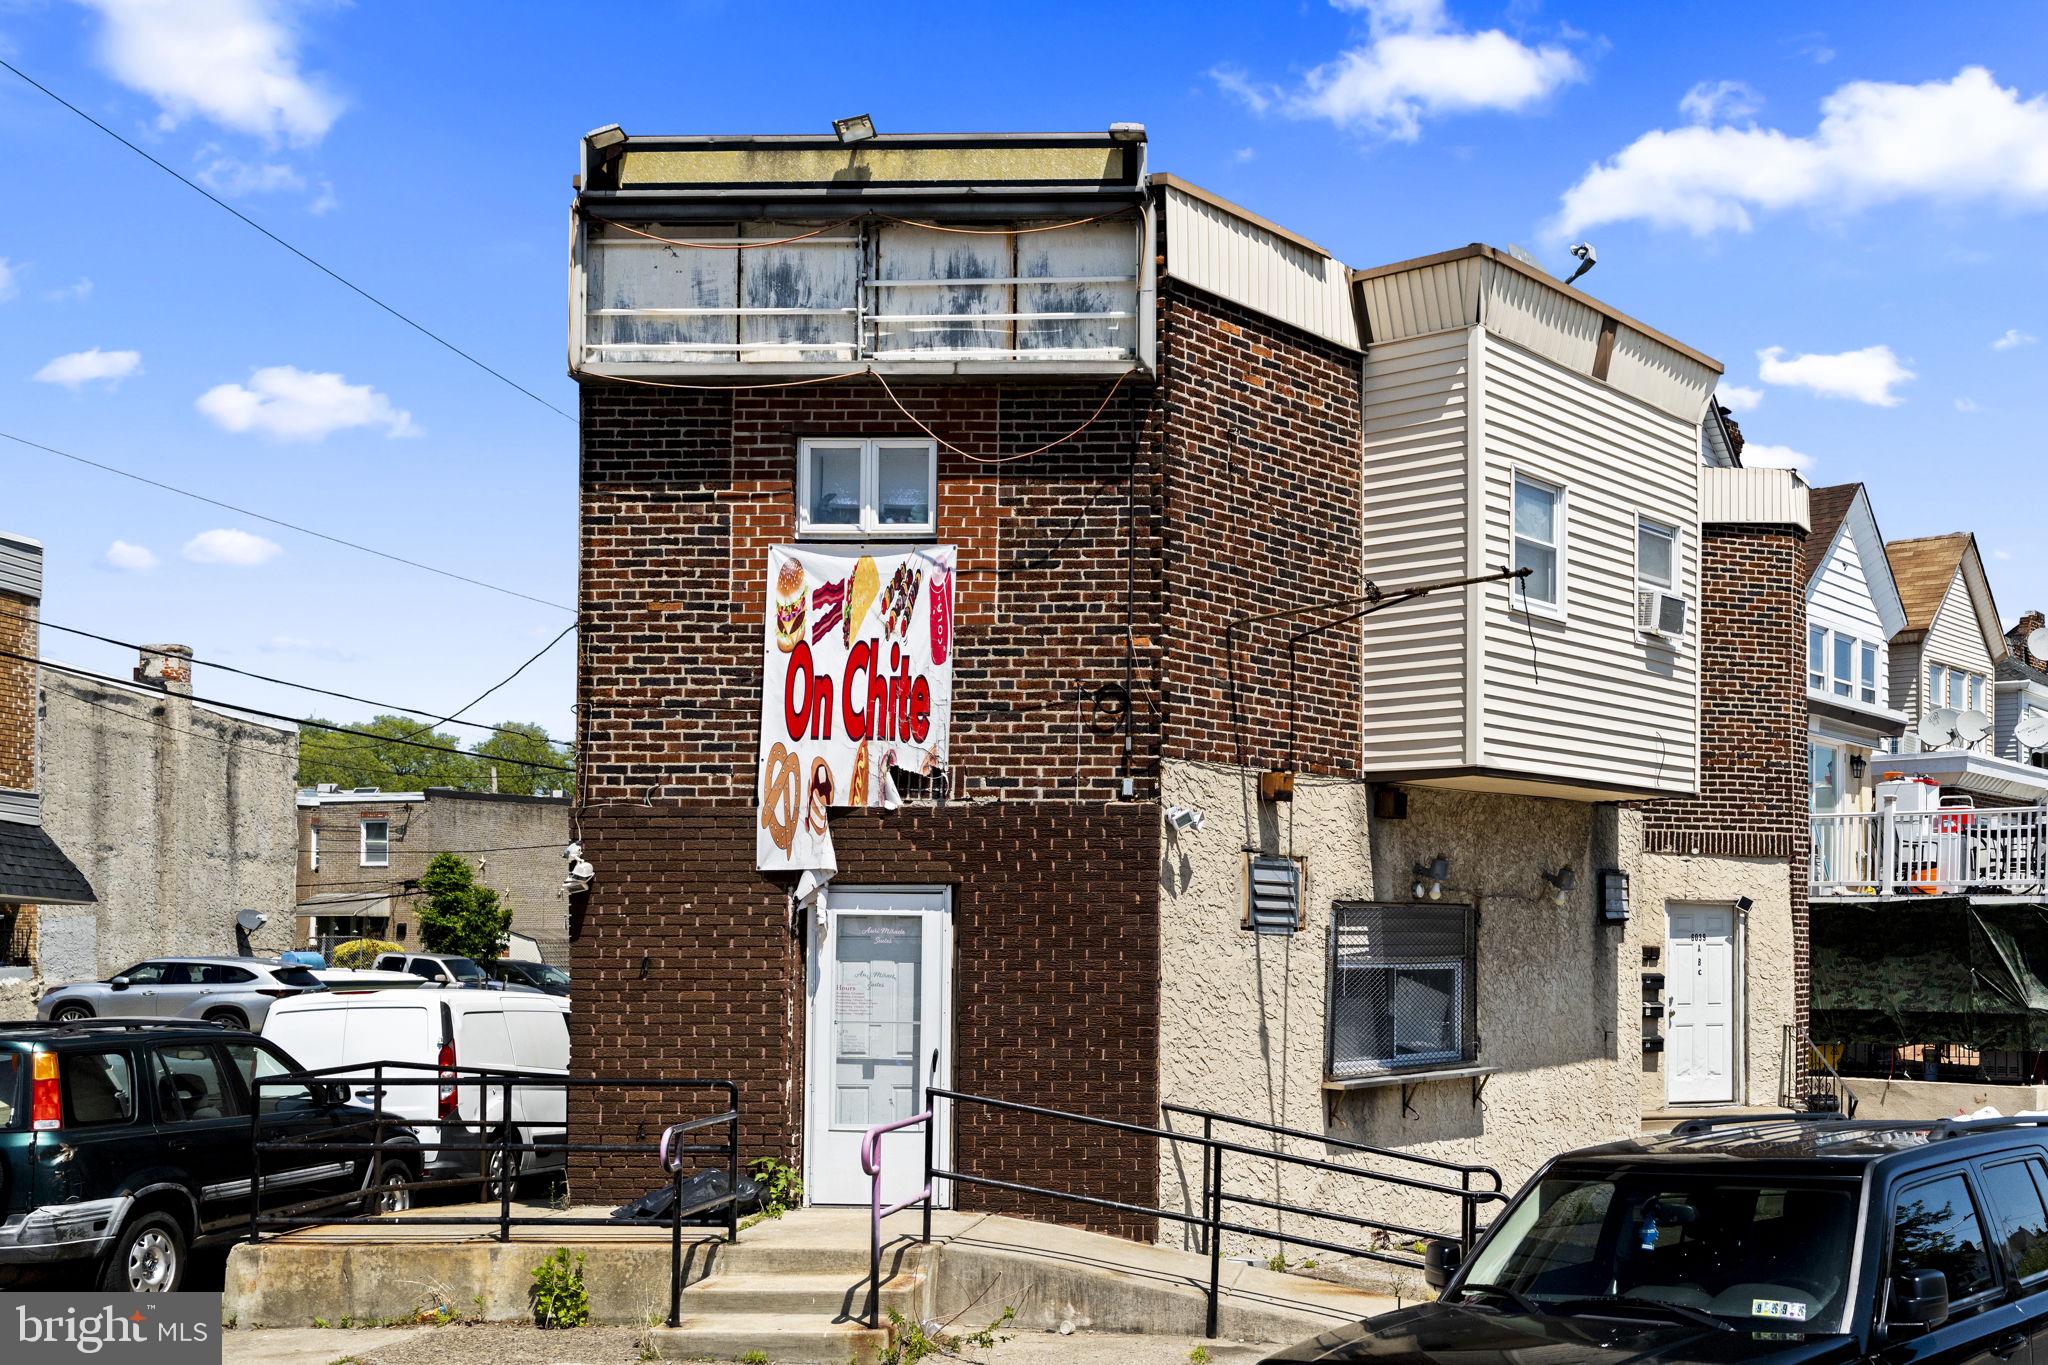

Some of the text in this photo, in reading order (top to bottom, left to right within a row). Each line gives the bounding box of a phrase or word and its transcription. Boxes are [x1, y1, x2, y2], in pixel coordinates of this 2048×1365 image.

[785, 638, 931, 743] On Chite
[1697, 944, 1701, 952] A
